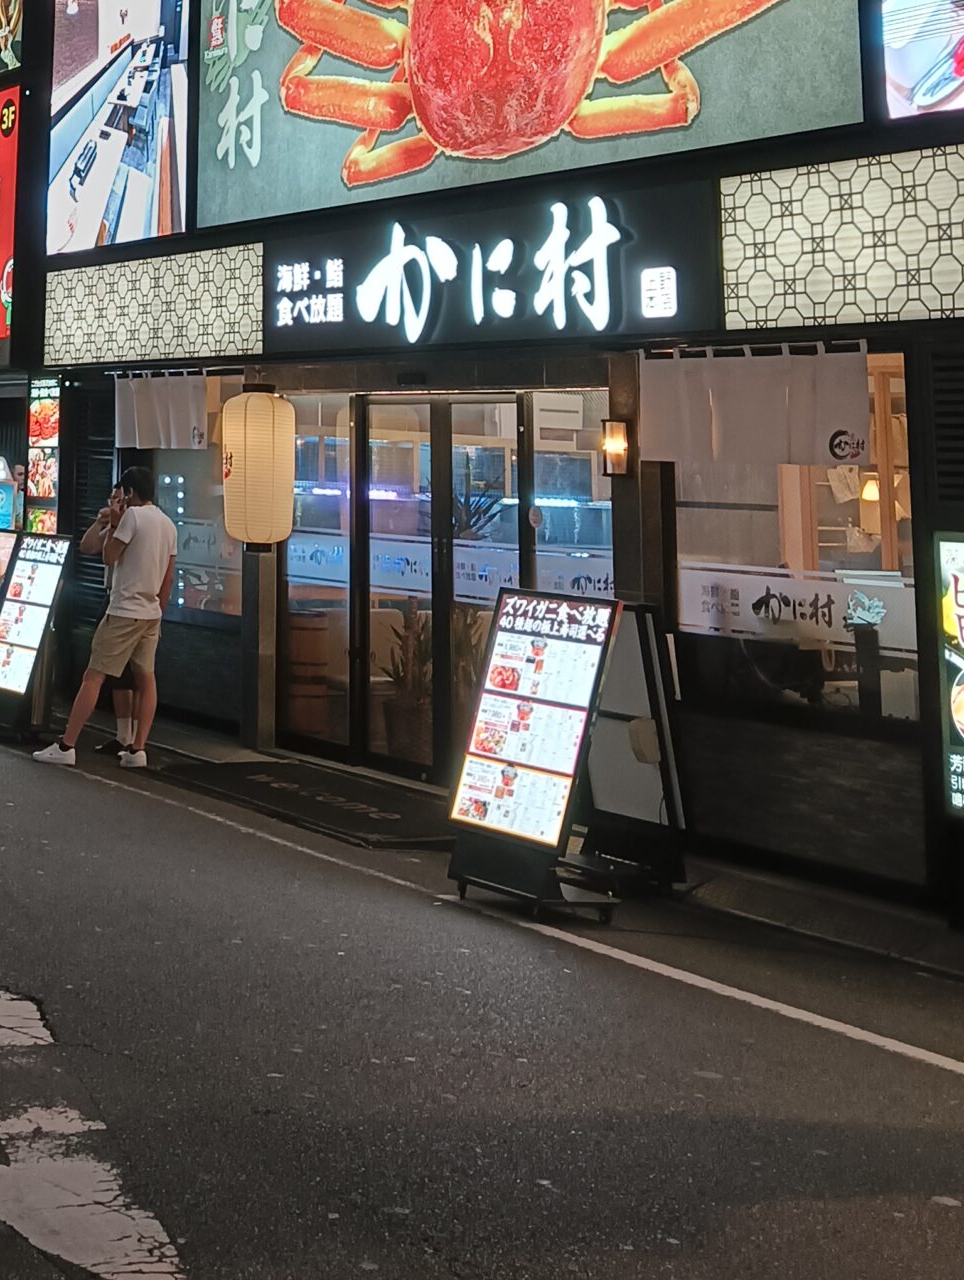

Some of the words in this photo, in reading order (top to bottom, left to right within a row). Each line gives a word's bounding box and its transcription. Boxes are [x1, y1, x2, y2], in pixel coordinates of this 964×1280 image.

[1, 105, 15, 131] 3F
[356, 194, 621, 344] かに村
[276, 292, 345, 327] 食べ放題
[751, 584, 836, 629] かに村
